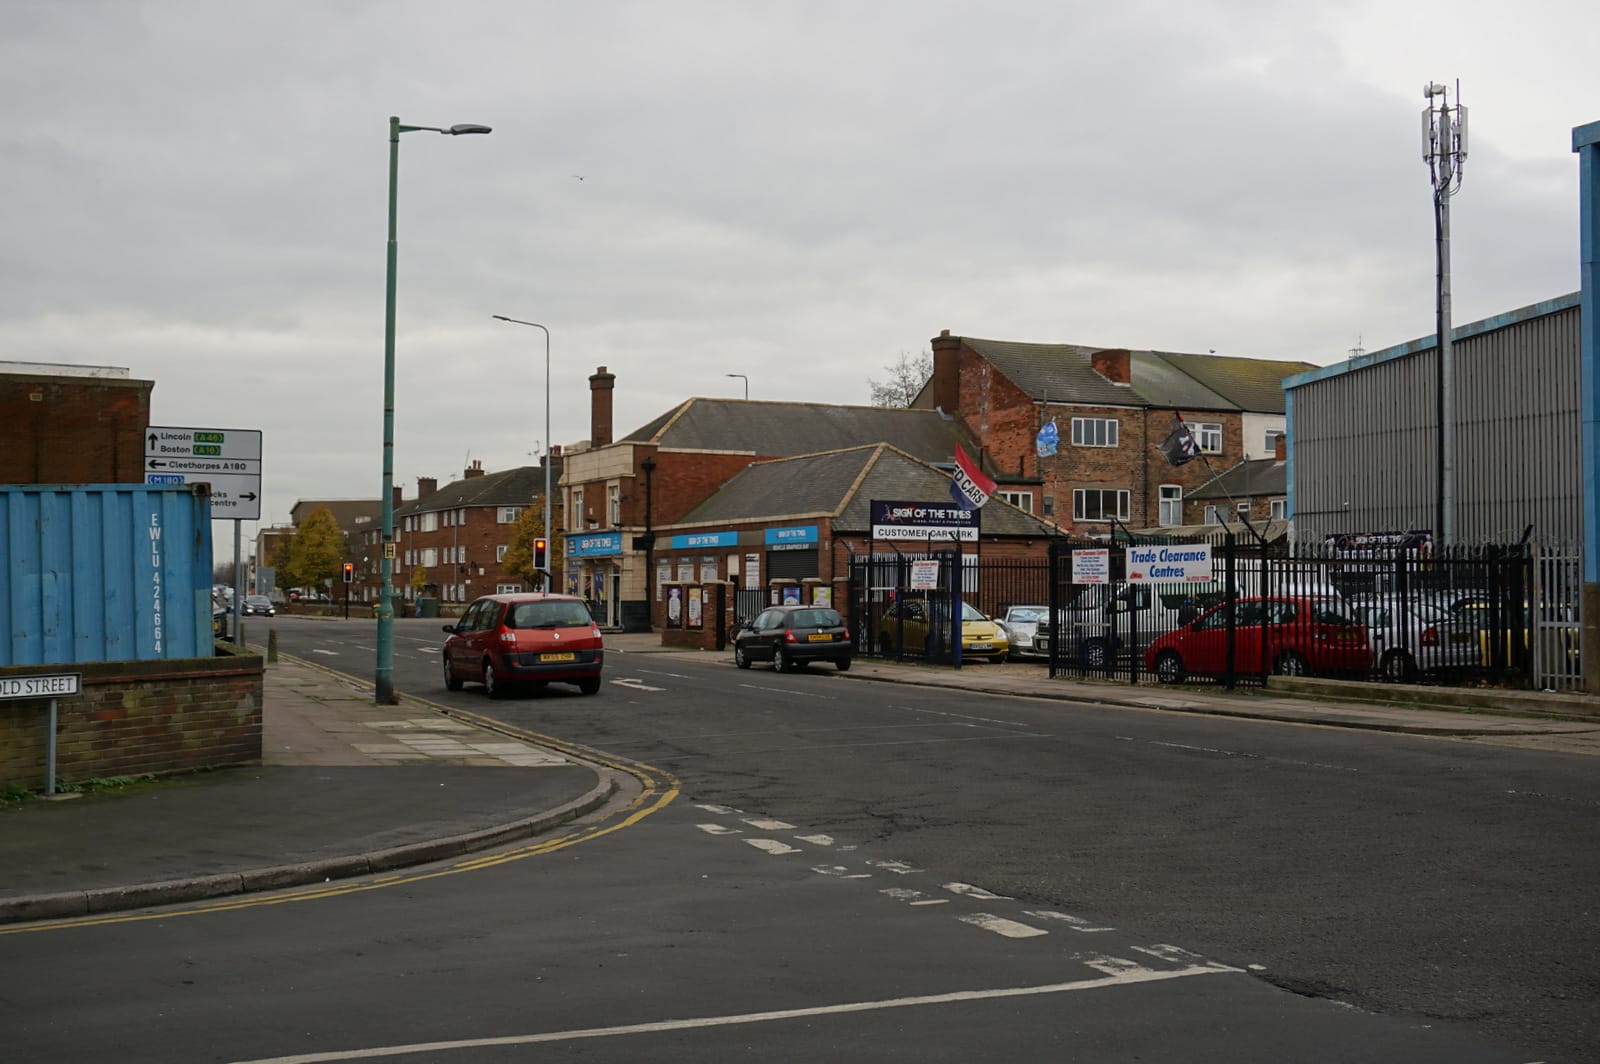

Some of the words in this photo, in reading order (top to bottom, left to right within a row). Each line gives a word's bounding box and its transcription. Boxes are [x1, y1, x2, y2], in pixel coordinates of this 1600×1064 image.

[160, 432, 191, 441] Lincoln
[160, 445, 191, 454] Boston
[168, 461, 221, 470] Cleethorpes
[223, 462, 247, 470] A180
[961, 479, 985, 503] CARS
[892, 507, 913, 518] SIGN
[914, 509, 927, 518] OF
[927, 509, 945, 519] THE
[878, 528, 928, 538] CUSTOMER
[930, 529, 948, 538] CAR
[149, 513, 161, 568] EWLU
[1131, 549, 1157, 563] Trade
[1159, 548, 1206, 563] Clearance
[1149, 565, 1185, 578] Centres
[152, 571, 162, 654] 424664
[0, 680, 21, 695] LD
[26, 678, 73, 693] STREET
